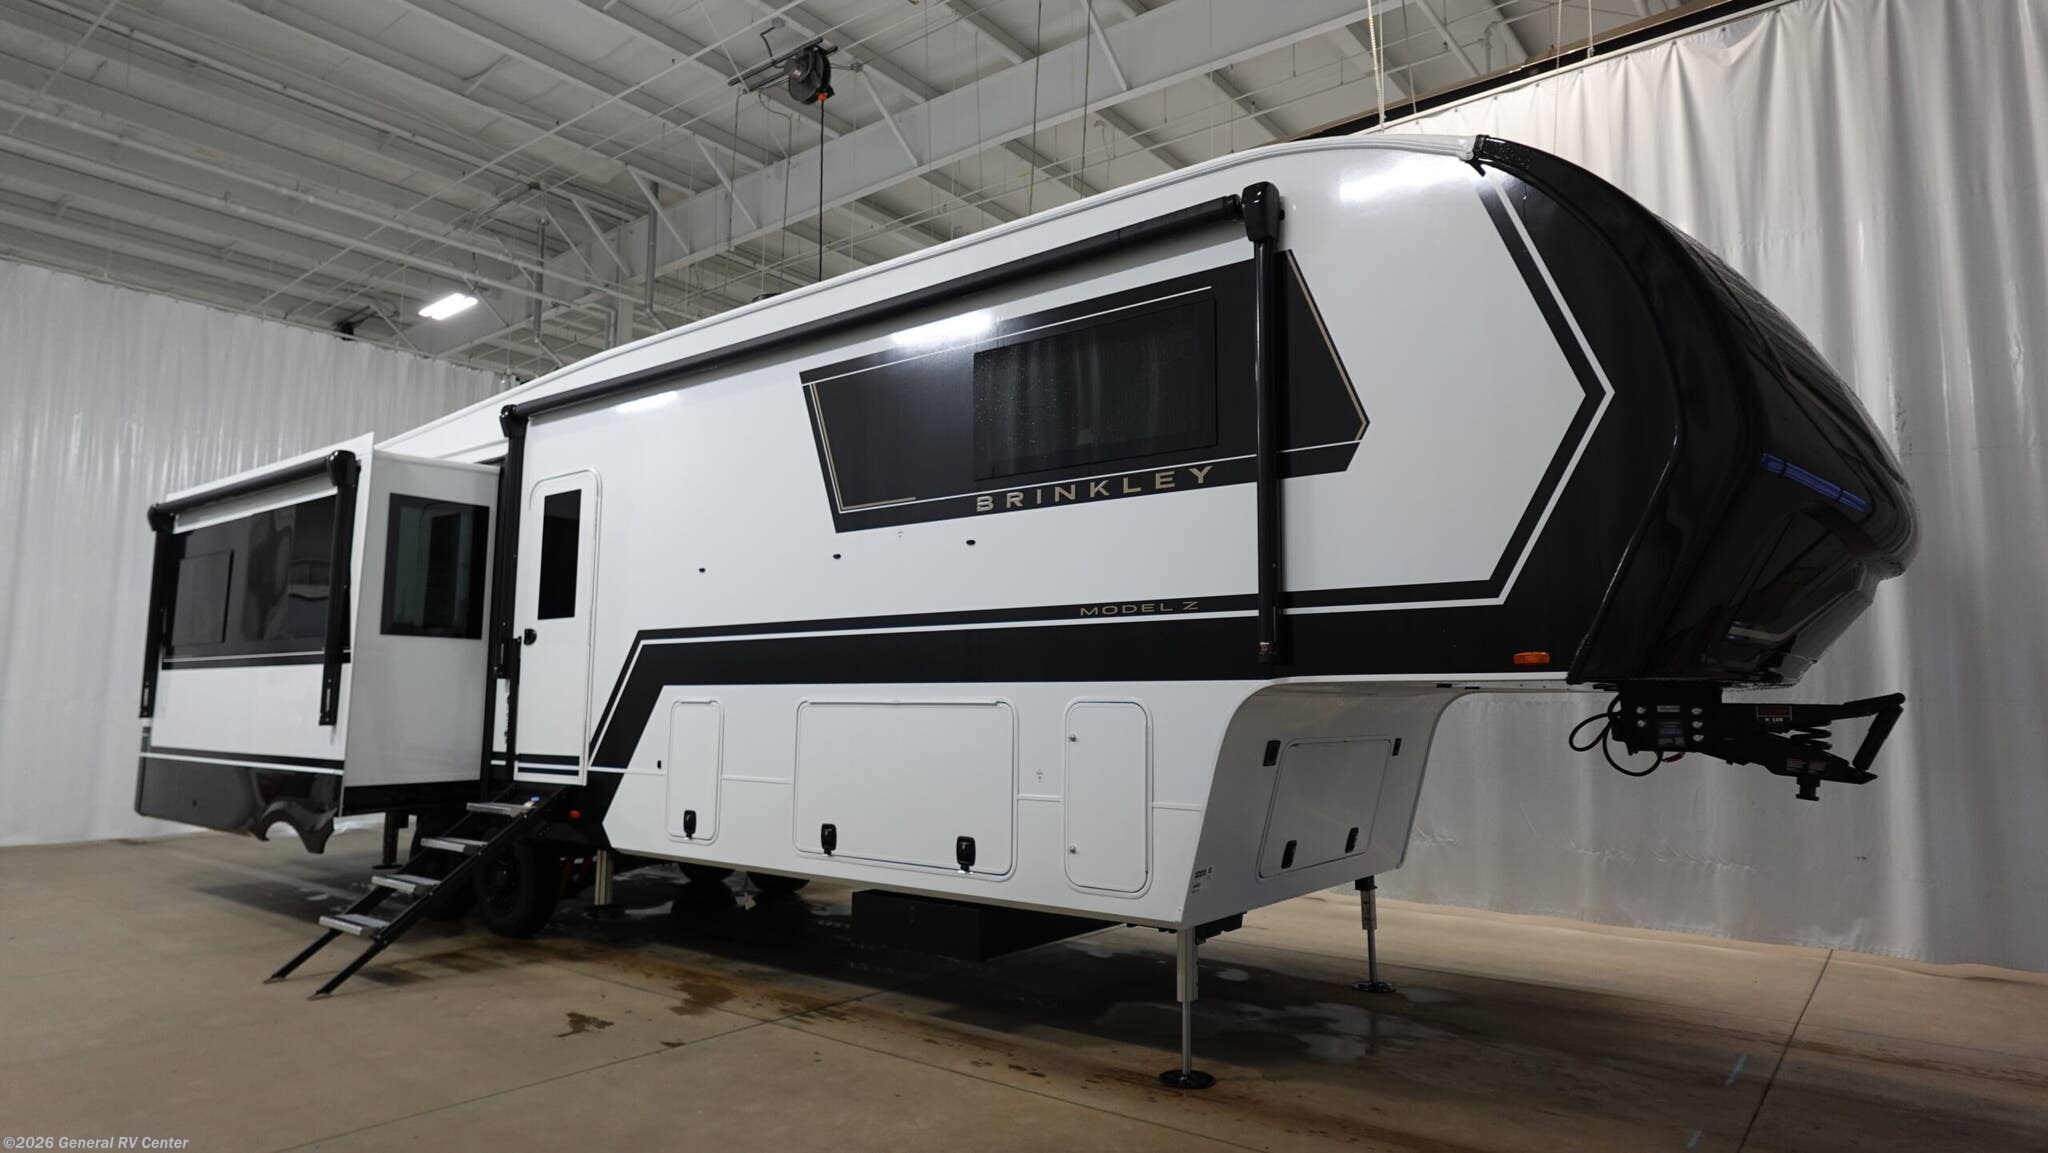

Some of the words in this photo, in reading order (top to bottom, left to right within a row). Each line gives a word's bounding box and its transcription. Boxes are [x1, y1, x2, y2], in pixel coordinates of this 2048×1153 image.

[976, 465, 1214, 512] BRINKLEY
[1080, 602, 1173, 616] MODEL
[1183, 601, 1200, 611] Z
